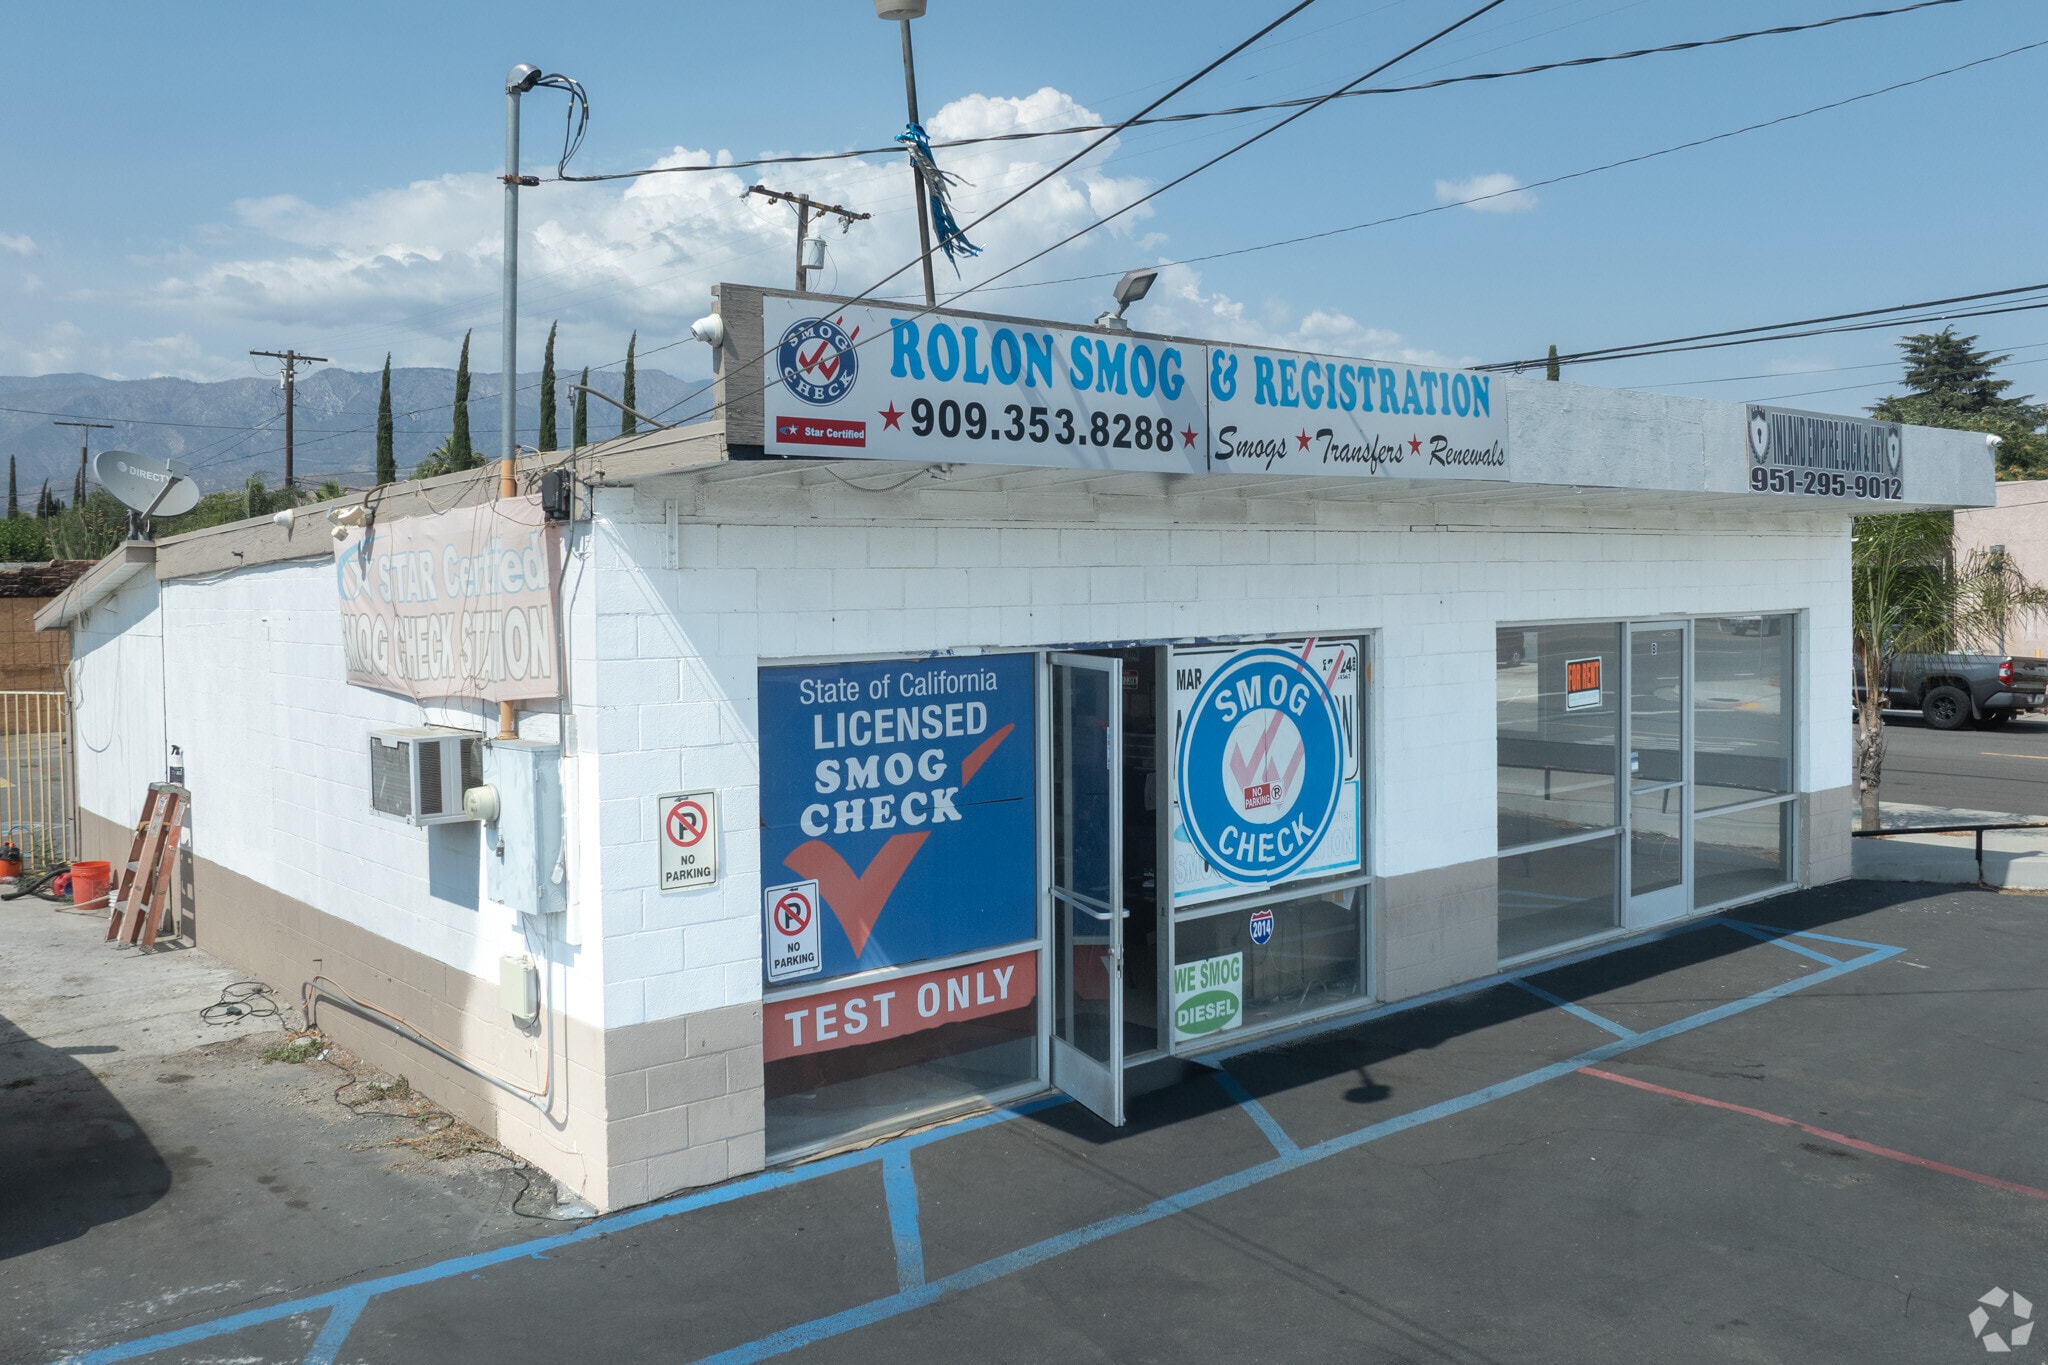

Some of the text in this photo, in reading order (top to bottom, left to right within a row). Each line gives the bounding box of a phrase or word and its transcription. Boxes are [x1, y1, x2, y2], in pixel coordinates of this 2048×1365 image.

[788, 325, 848, 351] SMOG
[784, 366, 854, 400] CHECK
[890, 317, 1491, 419] ROLON SMOG & REGISTRATION
[804, 426, 865, 440] Star Certified
[910, 397, 1175, 453] 909.353.8288
[1771, 413, 1885, 474] INLAND EMPIRE LOCK & KEY
[1214, 425, 1506, 475] Smogs Transfers Renewals
[1751, 466, 1903, 500] 951-295-9012
[378, 550, 438, 604] STAR
[393, 613, 455, 682] CHECK
[800, 668, 998, 705] State of California
[1215, 674, 1311, 723] SMOG
[813, 701, 988, 750] LICENSED
[814, 748, 948, 794] SMOG
[1245, 794, 1271, 809] PARKING
[1252, 787, 1263, 797] NO
[800, 786, 963, 837] CHECK
[1218, 811, 1315, 864] CHECK
[666, 866, 712, 882] PARKING
[680, 854, 696, 866] NO
[787, 941, 801, 953] NO
[1252, 919, 1272, 938] 2014
[774, 952, 815, 970] PARKING
[1174, 956, 1241, 995] WE SMOG
[784, 964, 1015, 1048] TEST ONLY
[1177, 999, 1236, 1027] DIESEL
